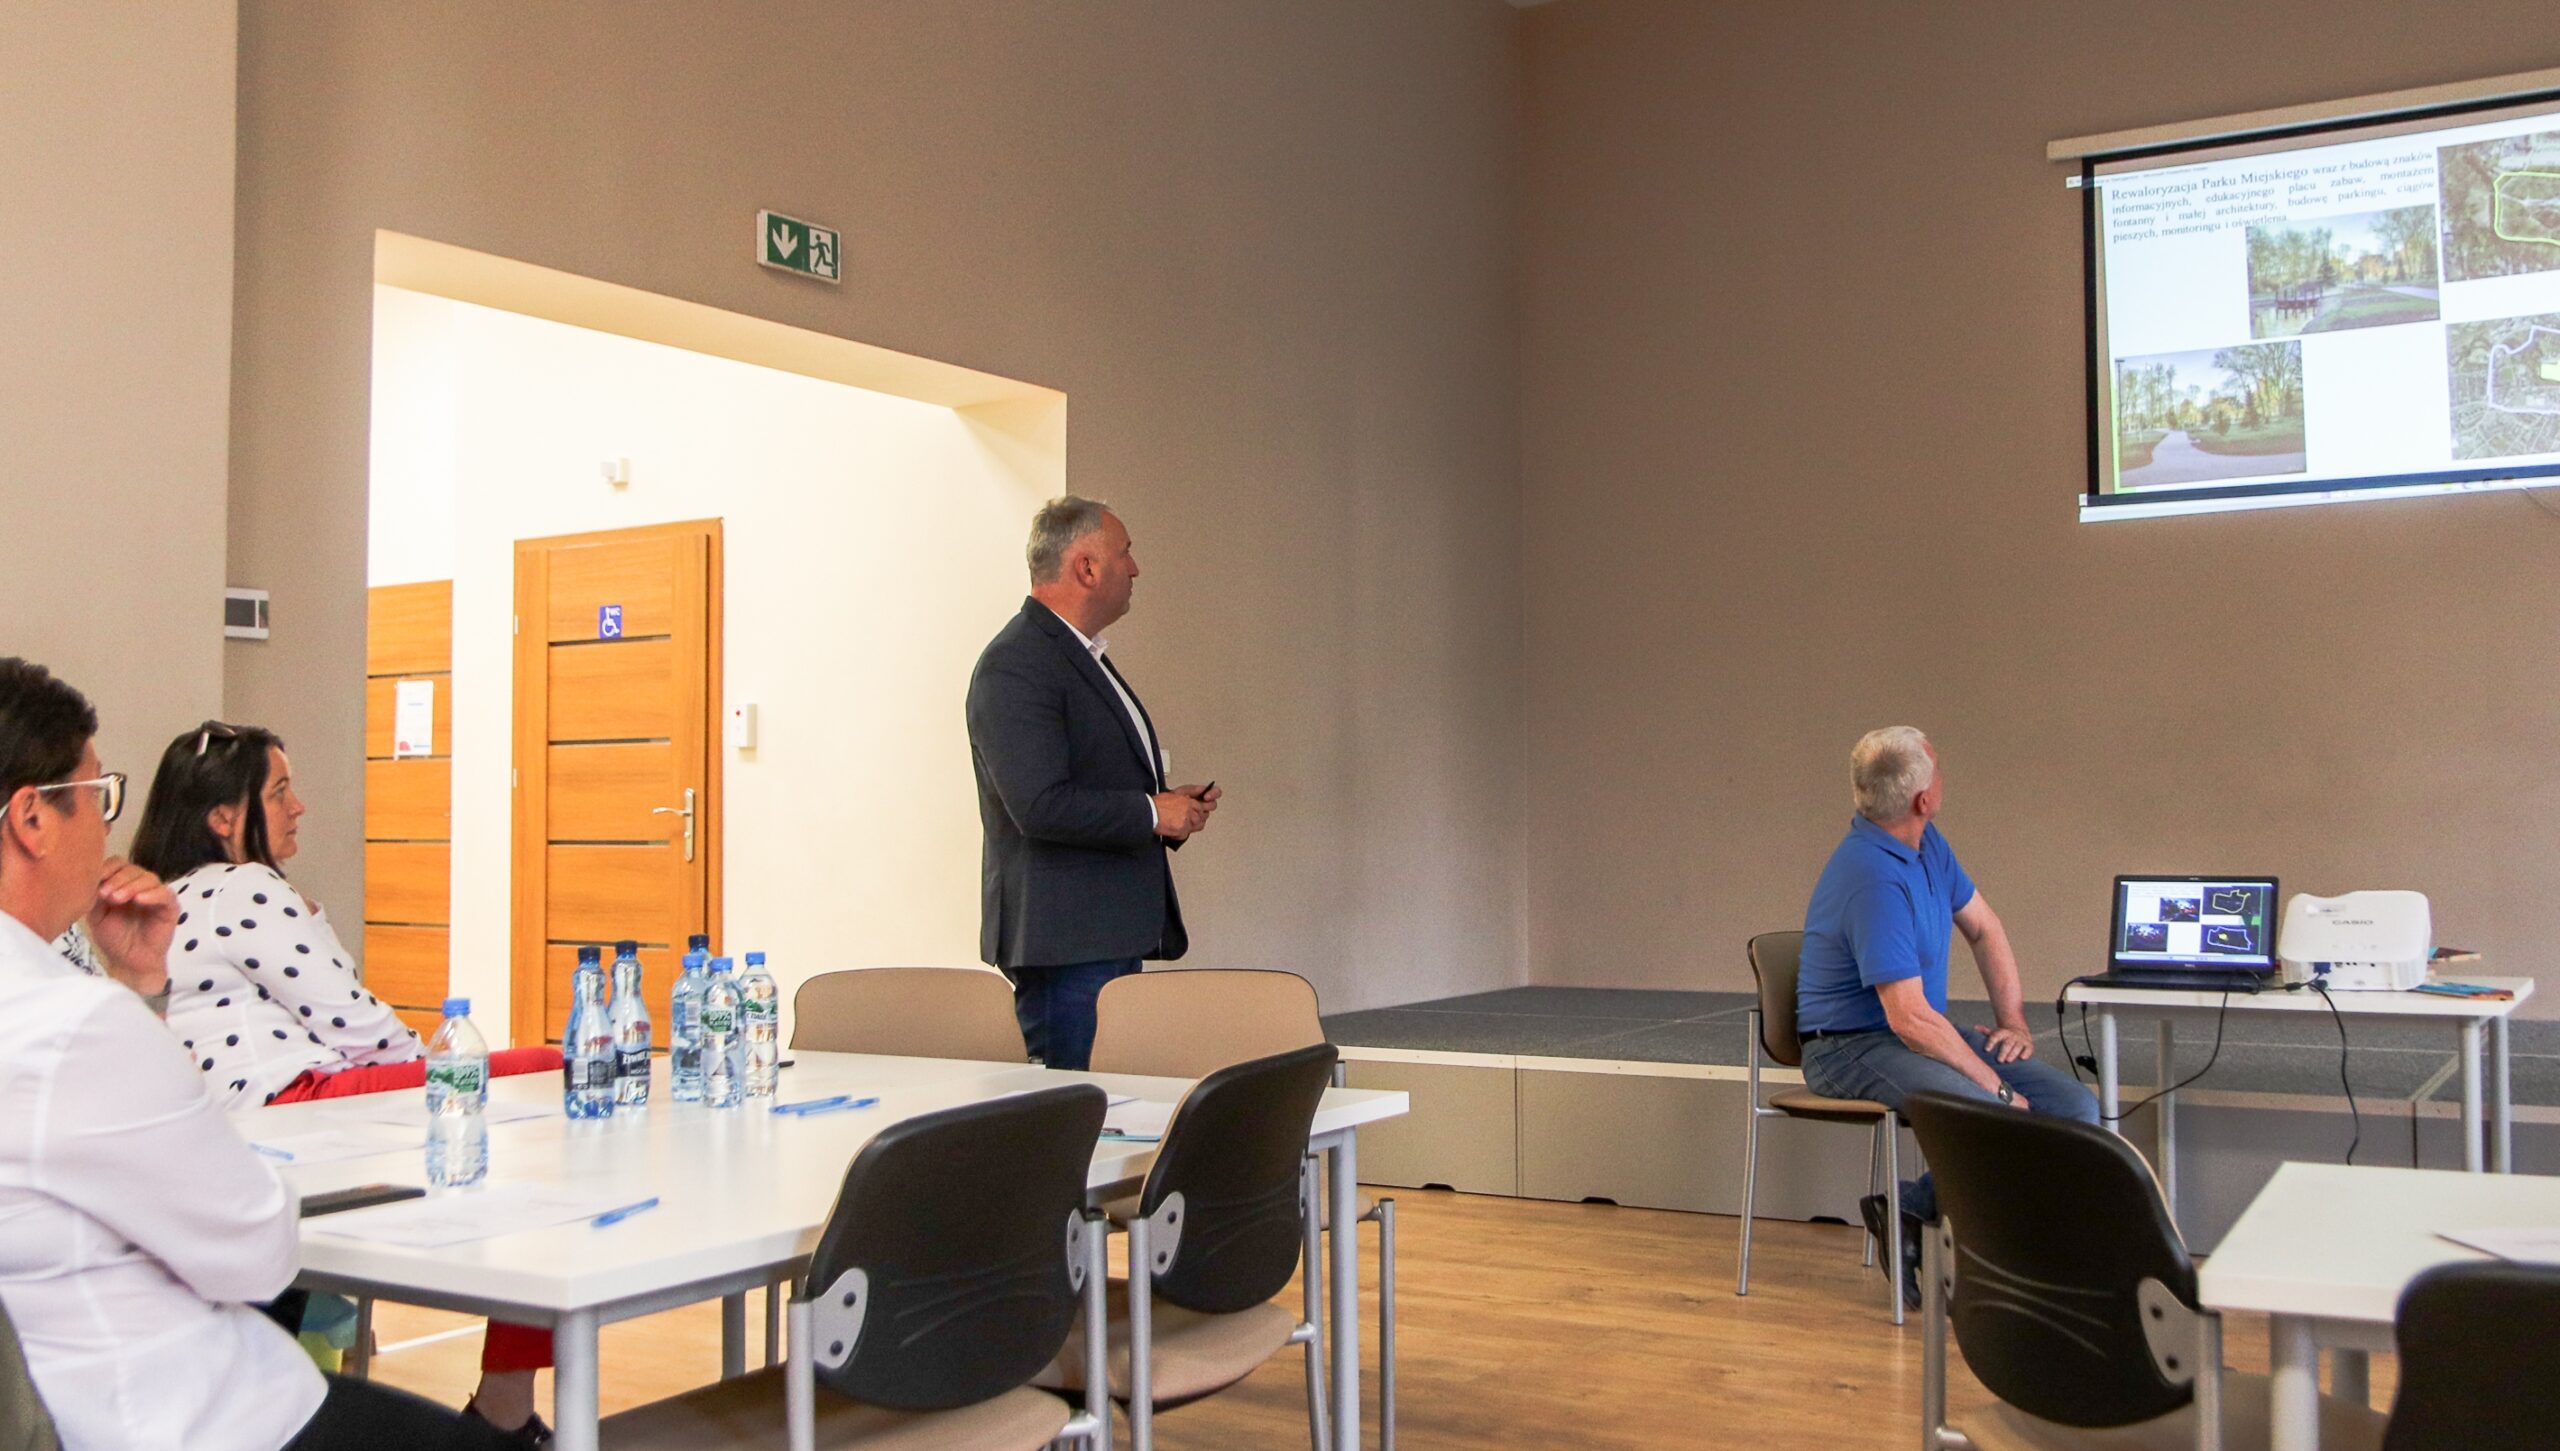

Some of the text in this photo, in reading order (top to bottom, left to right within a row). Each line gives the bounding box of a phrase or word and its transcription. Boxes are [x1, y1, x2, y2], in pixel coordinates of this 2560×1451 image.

[2112, 184, 2198, 200] Rewaloryzacja
[2202, 176, 2236, 189] Parku
[2241, 168, 2309, 185] Miejskiego
[2313, 165, 2337, 175] wraz
[2112, 197, 2192, 214] informacyjnych,
[2205, 188, 2275, 203] edukacyjnego
[2288, 181, 2316, 194] placu
[2113, 216, 2155, 229] fontanny
[2113, 229, 2158, 244] pieszych,
[2161, 222, 2221, 237] monitoringu
